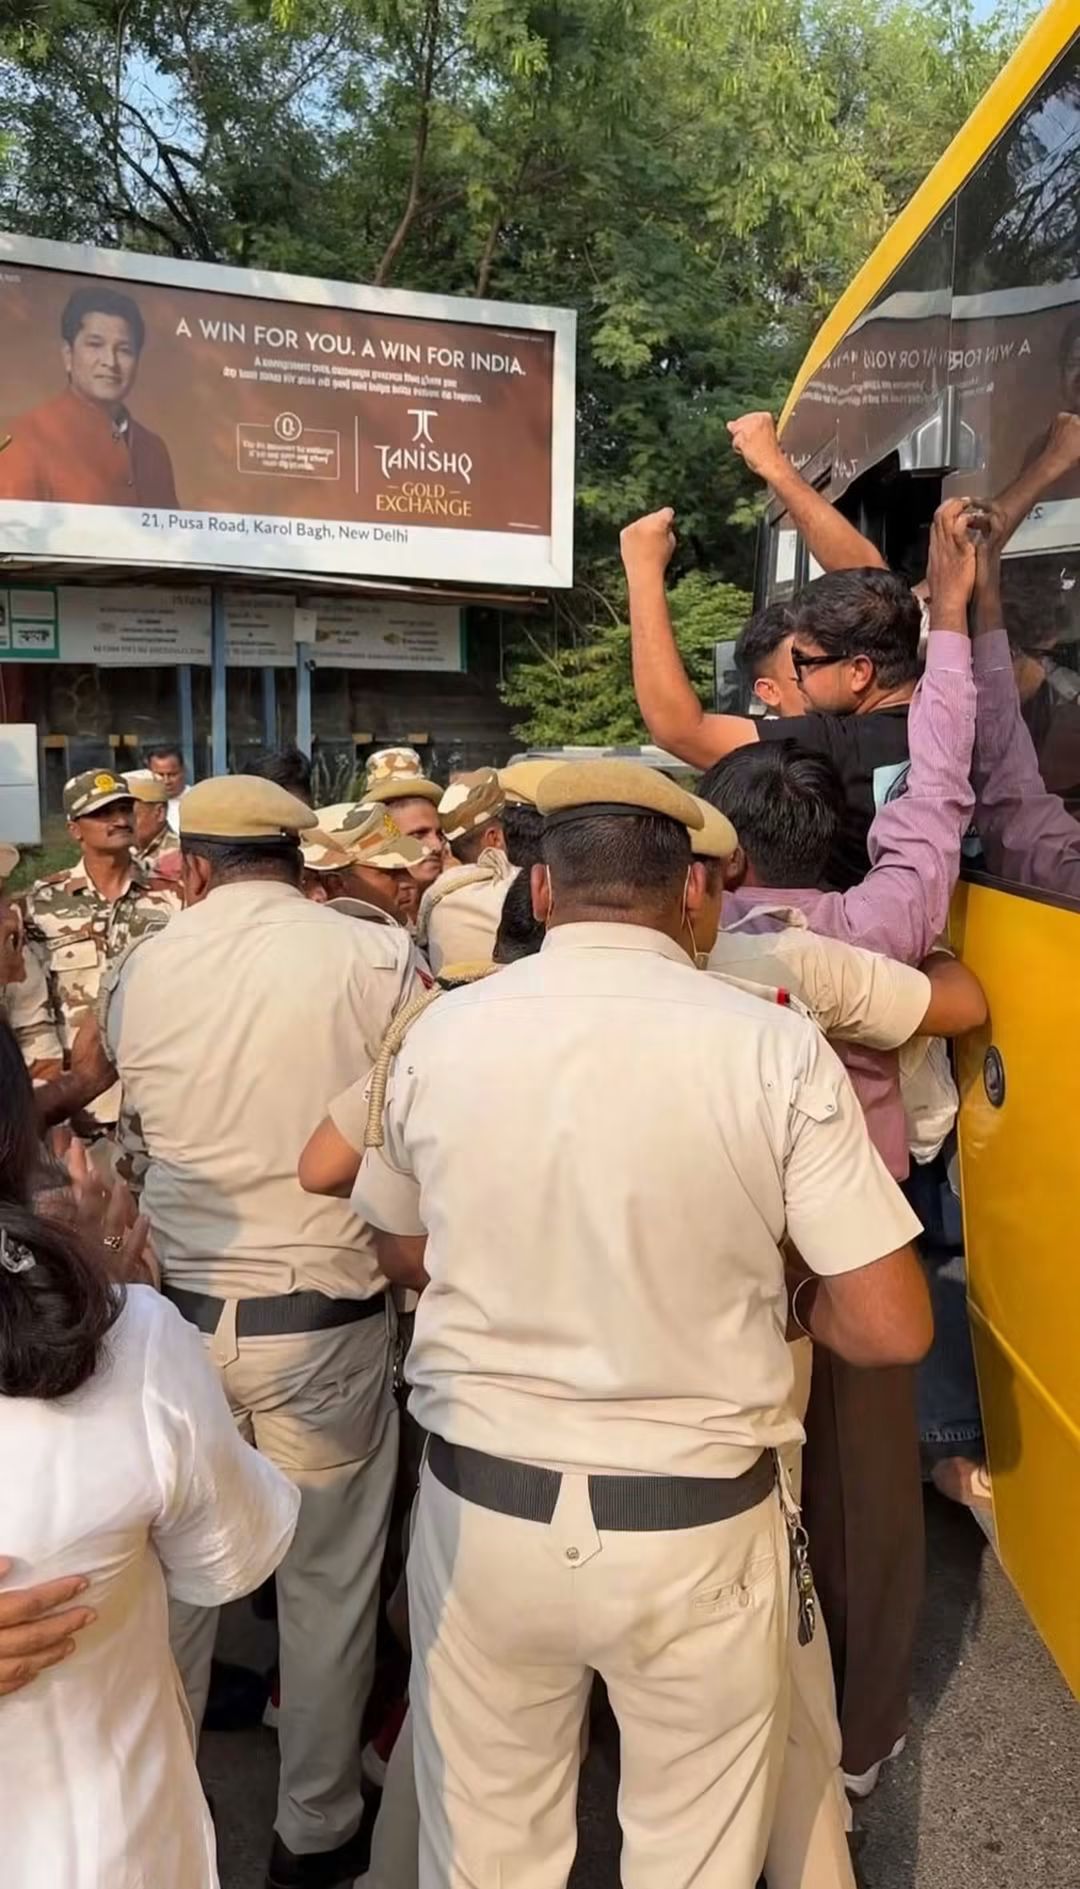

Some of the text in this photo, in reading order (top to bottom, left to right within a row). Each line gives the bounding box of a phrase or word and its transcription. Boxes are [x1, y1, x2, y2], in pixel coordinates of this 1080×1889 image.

[176, 317, 192, 338] A
[199, 319, 246, 343] WIN
[254, 325, 299, 349] FOR
[305, 331, 356, 356] YOU.
[361, 338, 376, 358] A
[380, 339, 421, 363] WIN
[427, 346, 465, 368] FOR
[471, 352, 527, 376] INDIA.
[402, 481, 445, 499] GOLD
[376, 494, 472, 517] EXCHANGE
[141, 512, 409, 543] 21, Pusa Road, Karol Bagh, New Delhi
